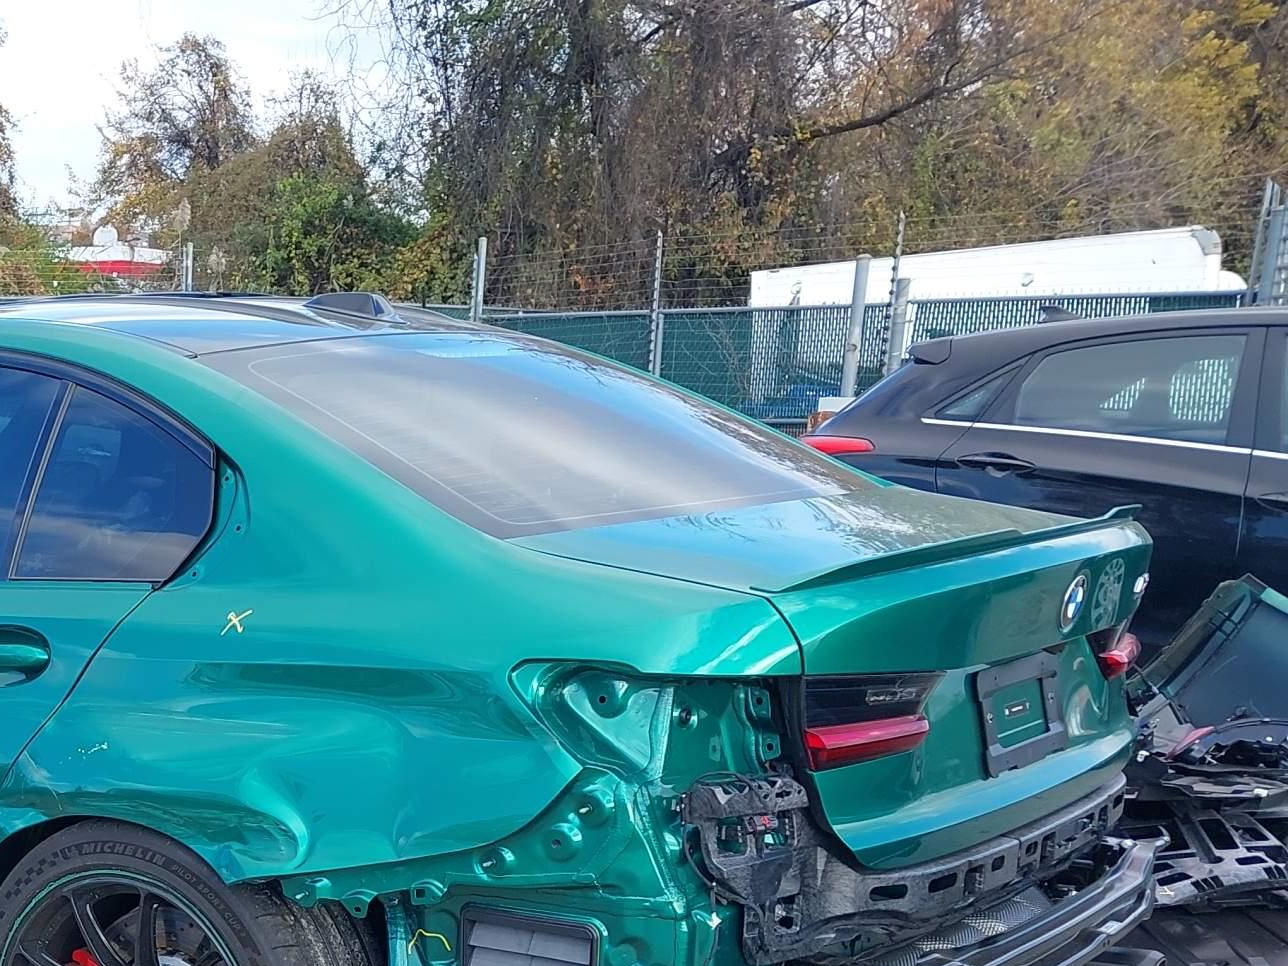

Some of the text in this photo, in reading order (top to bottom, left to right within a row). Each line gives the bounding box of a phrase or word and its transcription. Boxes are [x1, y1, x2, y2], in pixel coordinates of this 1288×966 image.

[81, 842, 167, 866] MICHELIN
[171, 864, 197, 883] PILOT
[198, 882, 226, 910] SPORT
[223, 911, 242, 930] CUP
